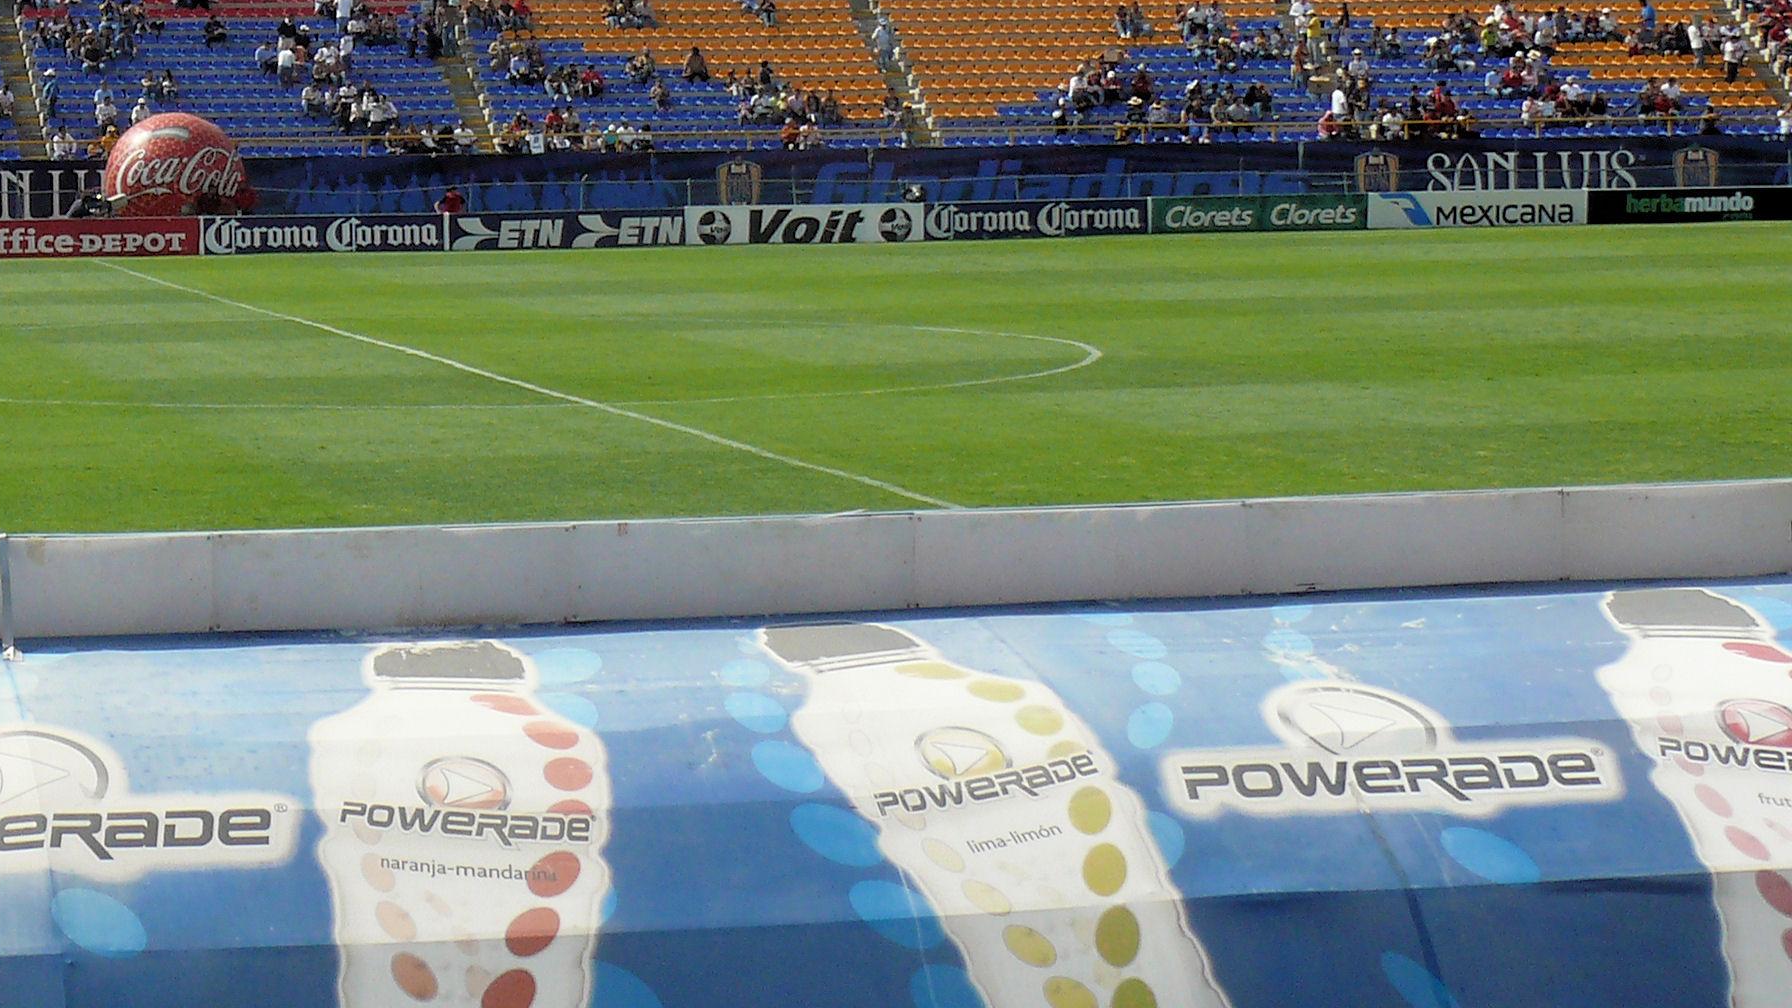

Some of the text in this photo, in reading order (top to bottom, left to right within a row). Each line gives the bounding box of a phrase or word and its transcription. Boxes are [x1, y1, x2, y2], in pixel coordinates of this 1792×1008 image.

[1427, 150, 1637, 192] SAN LUIS
[1164, 203, 1357, 229] Clorets Clorets
[1626, 191, 1754, 213] herbamundo
[207, 215, 439, 254] Corona Corona
[497, 216, 684, 249] ETN ETN
[749, 208, 864, 243] Voit
[925, 201, 1142, 240] Corona Corona
[79, 232, 187, 253] DEPOT
[965, 824, 1063, 855] lima-limón
[380, 855, 559, 883] naranja-mandarina
